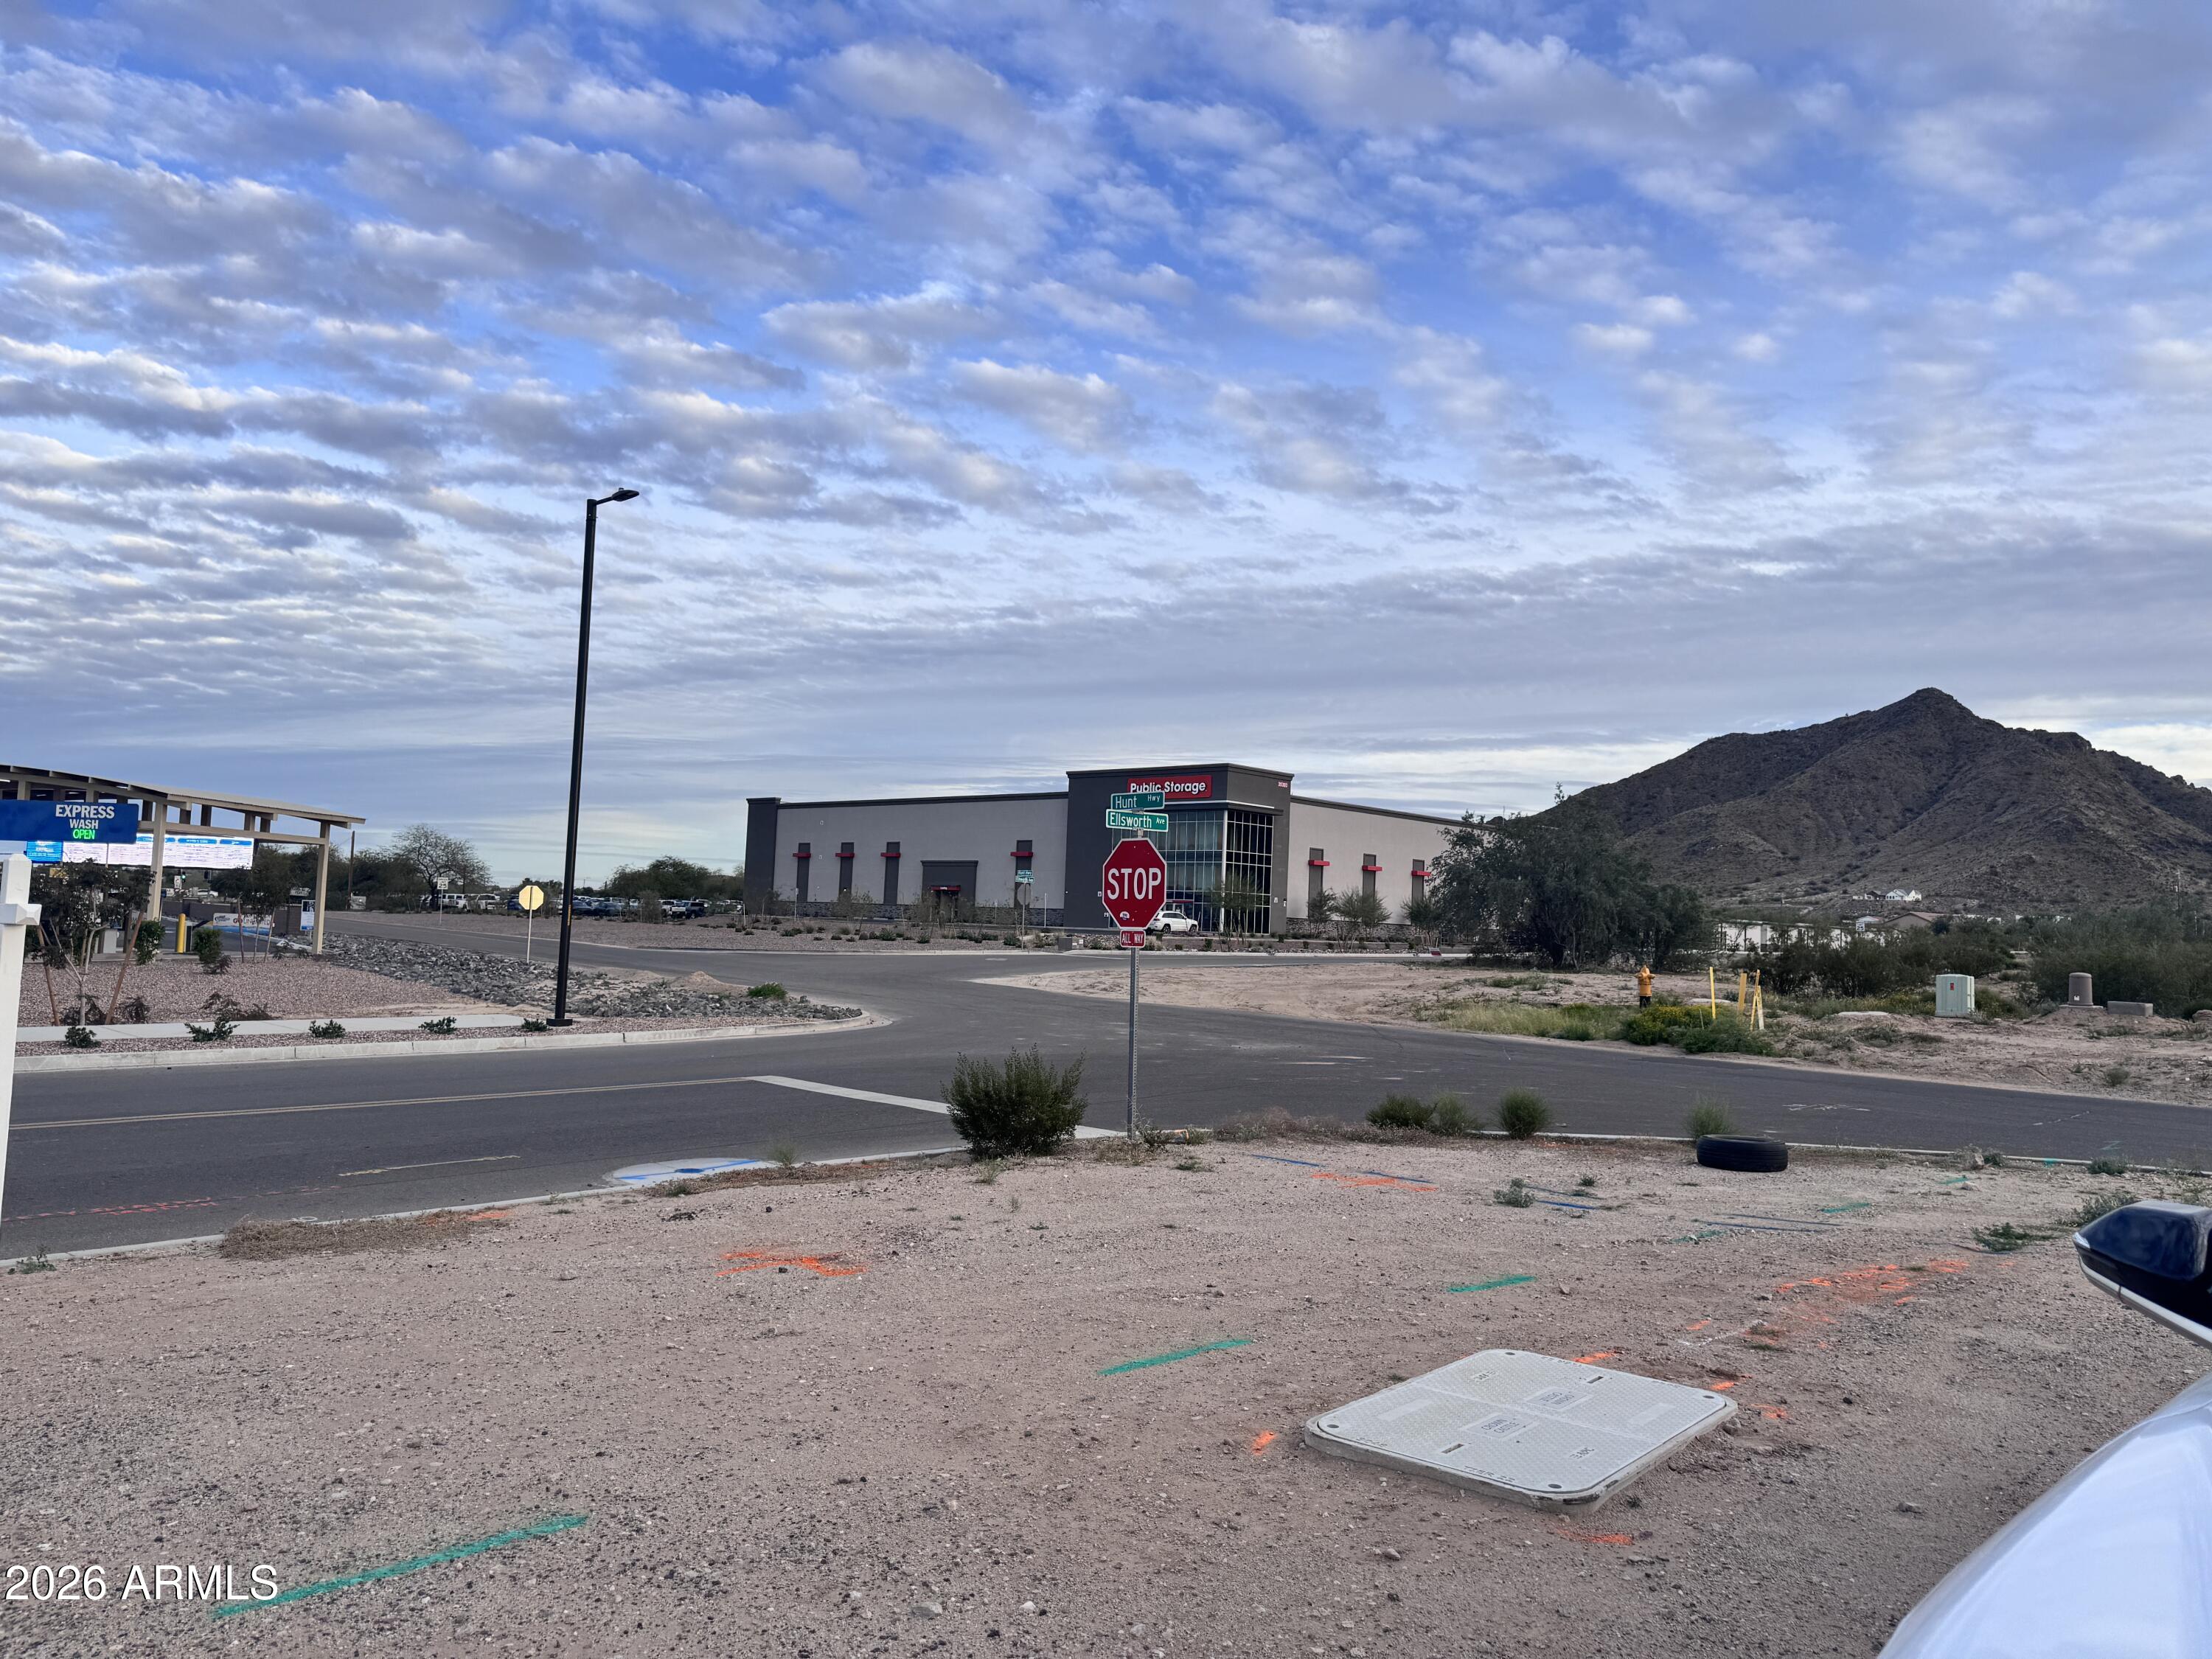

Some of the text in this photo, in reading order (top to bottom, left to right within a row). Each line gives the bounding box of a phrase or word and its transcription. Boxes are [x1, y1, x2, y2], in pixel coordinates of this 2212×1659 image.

[1130, 781, 1206, 795] Public Storage
[1116, 796, 1137, 809] Hunt
[55, 804, 115, 819] EXPRESS
[69, 818, 99, 830] WASH
[1110, 812, 1152, 828] Ellsworth
[72, 829, 96, 840] OPEN
[1107, 868, 1162, 900] STOP
[1121, 933, 1144, 943] ALL WAY
